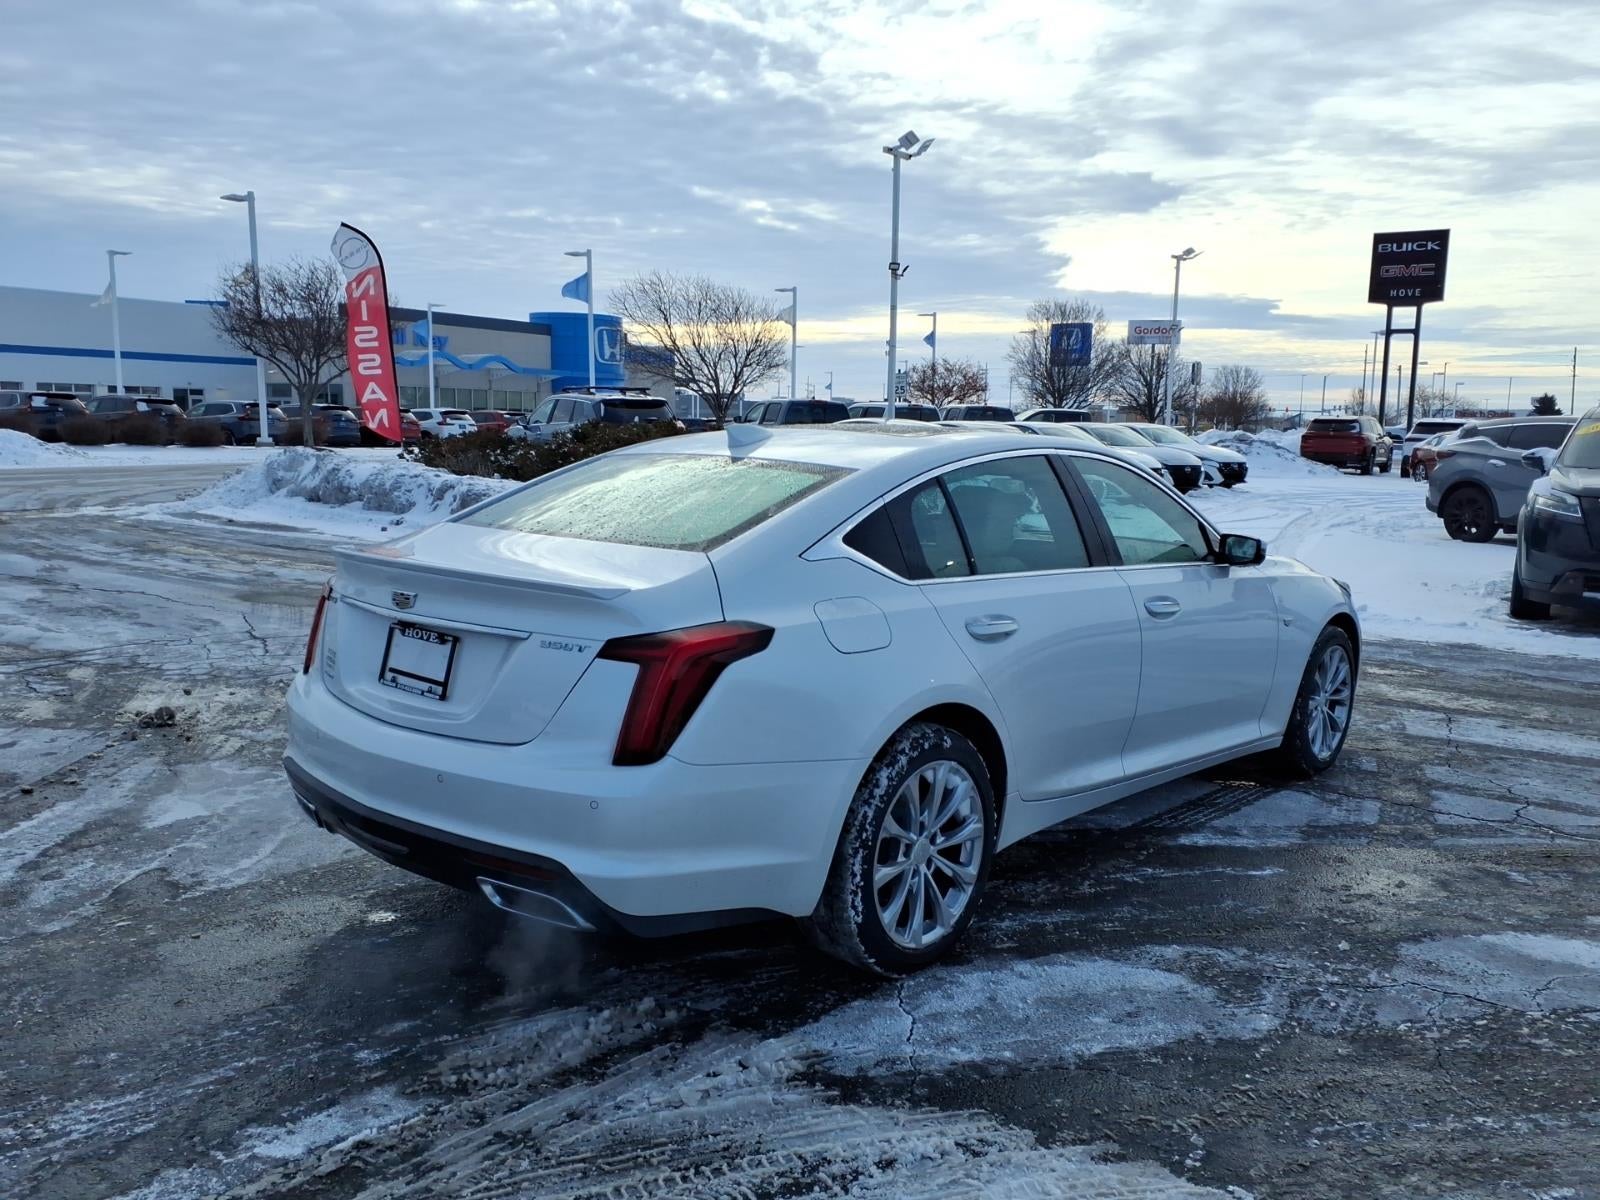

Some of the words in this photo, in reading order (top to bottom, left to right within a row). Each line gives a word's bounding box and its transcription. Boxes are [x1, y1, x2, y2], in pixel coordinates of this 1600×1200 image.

[1378, 240, 1441, 253] BUICK
[1381, 263, 1436, 278] GMC
[1390, 288, 1421, 297] HOVE
[895, 385, 906, 395] 25
[404, 627, 439, 642] HOVE
